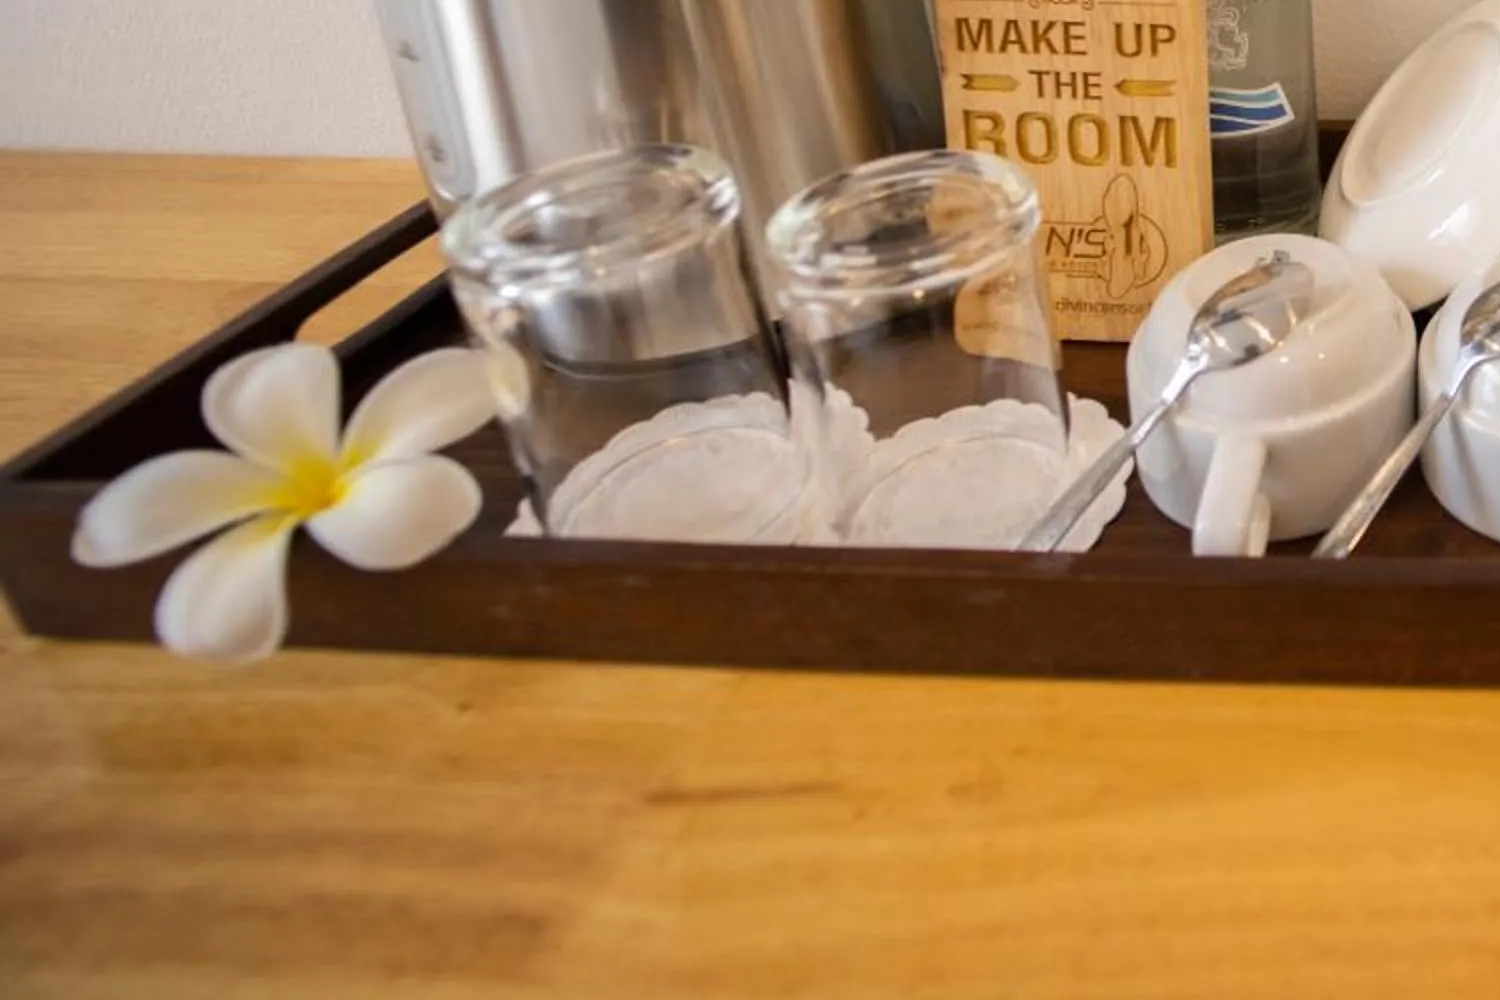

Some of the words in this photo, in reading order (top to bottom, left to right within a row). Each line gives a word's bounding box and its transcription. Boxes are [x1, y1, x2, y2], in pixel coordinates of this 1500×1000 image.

[955, 16, 1088, 56] MAKE
[1114, 22, 1177, 58] UP
[1028, 69, 1104, 101] THE
[961, 109, 1178, 169] ROOM
